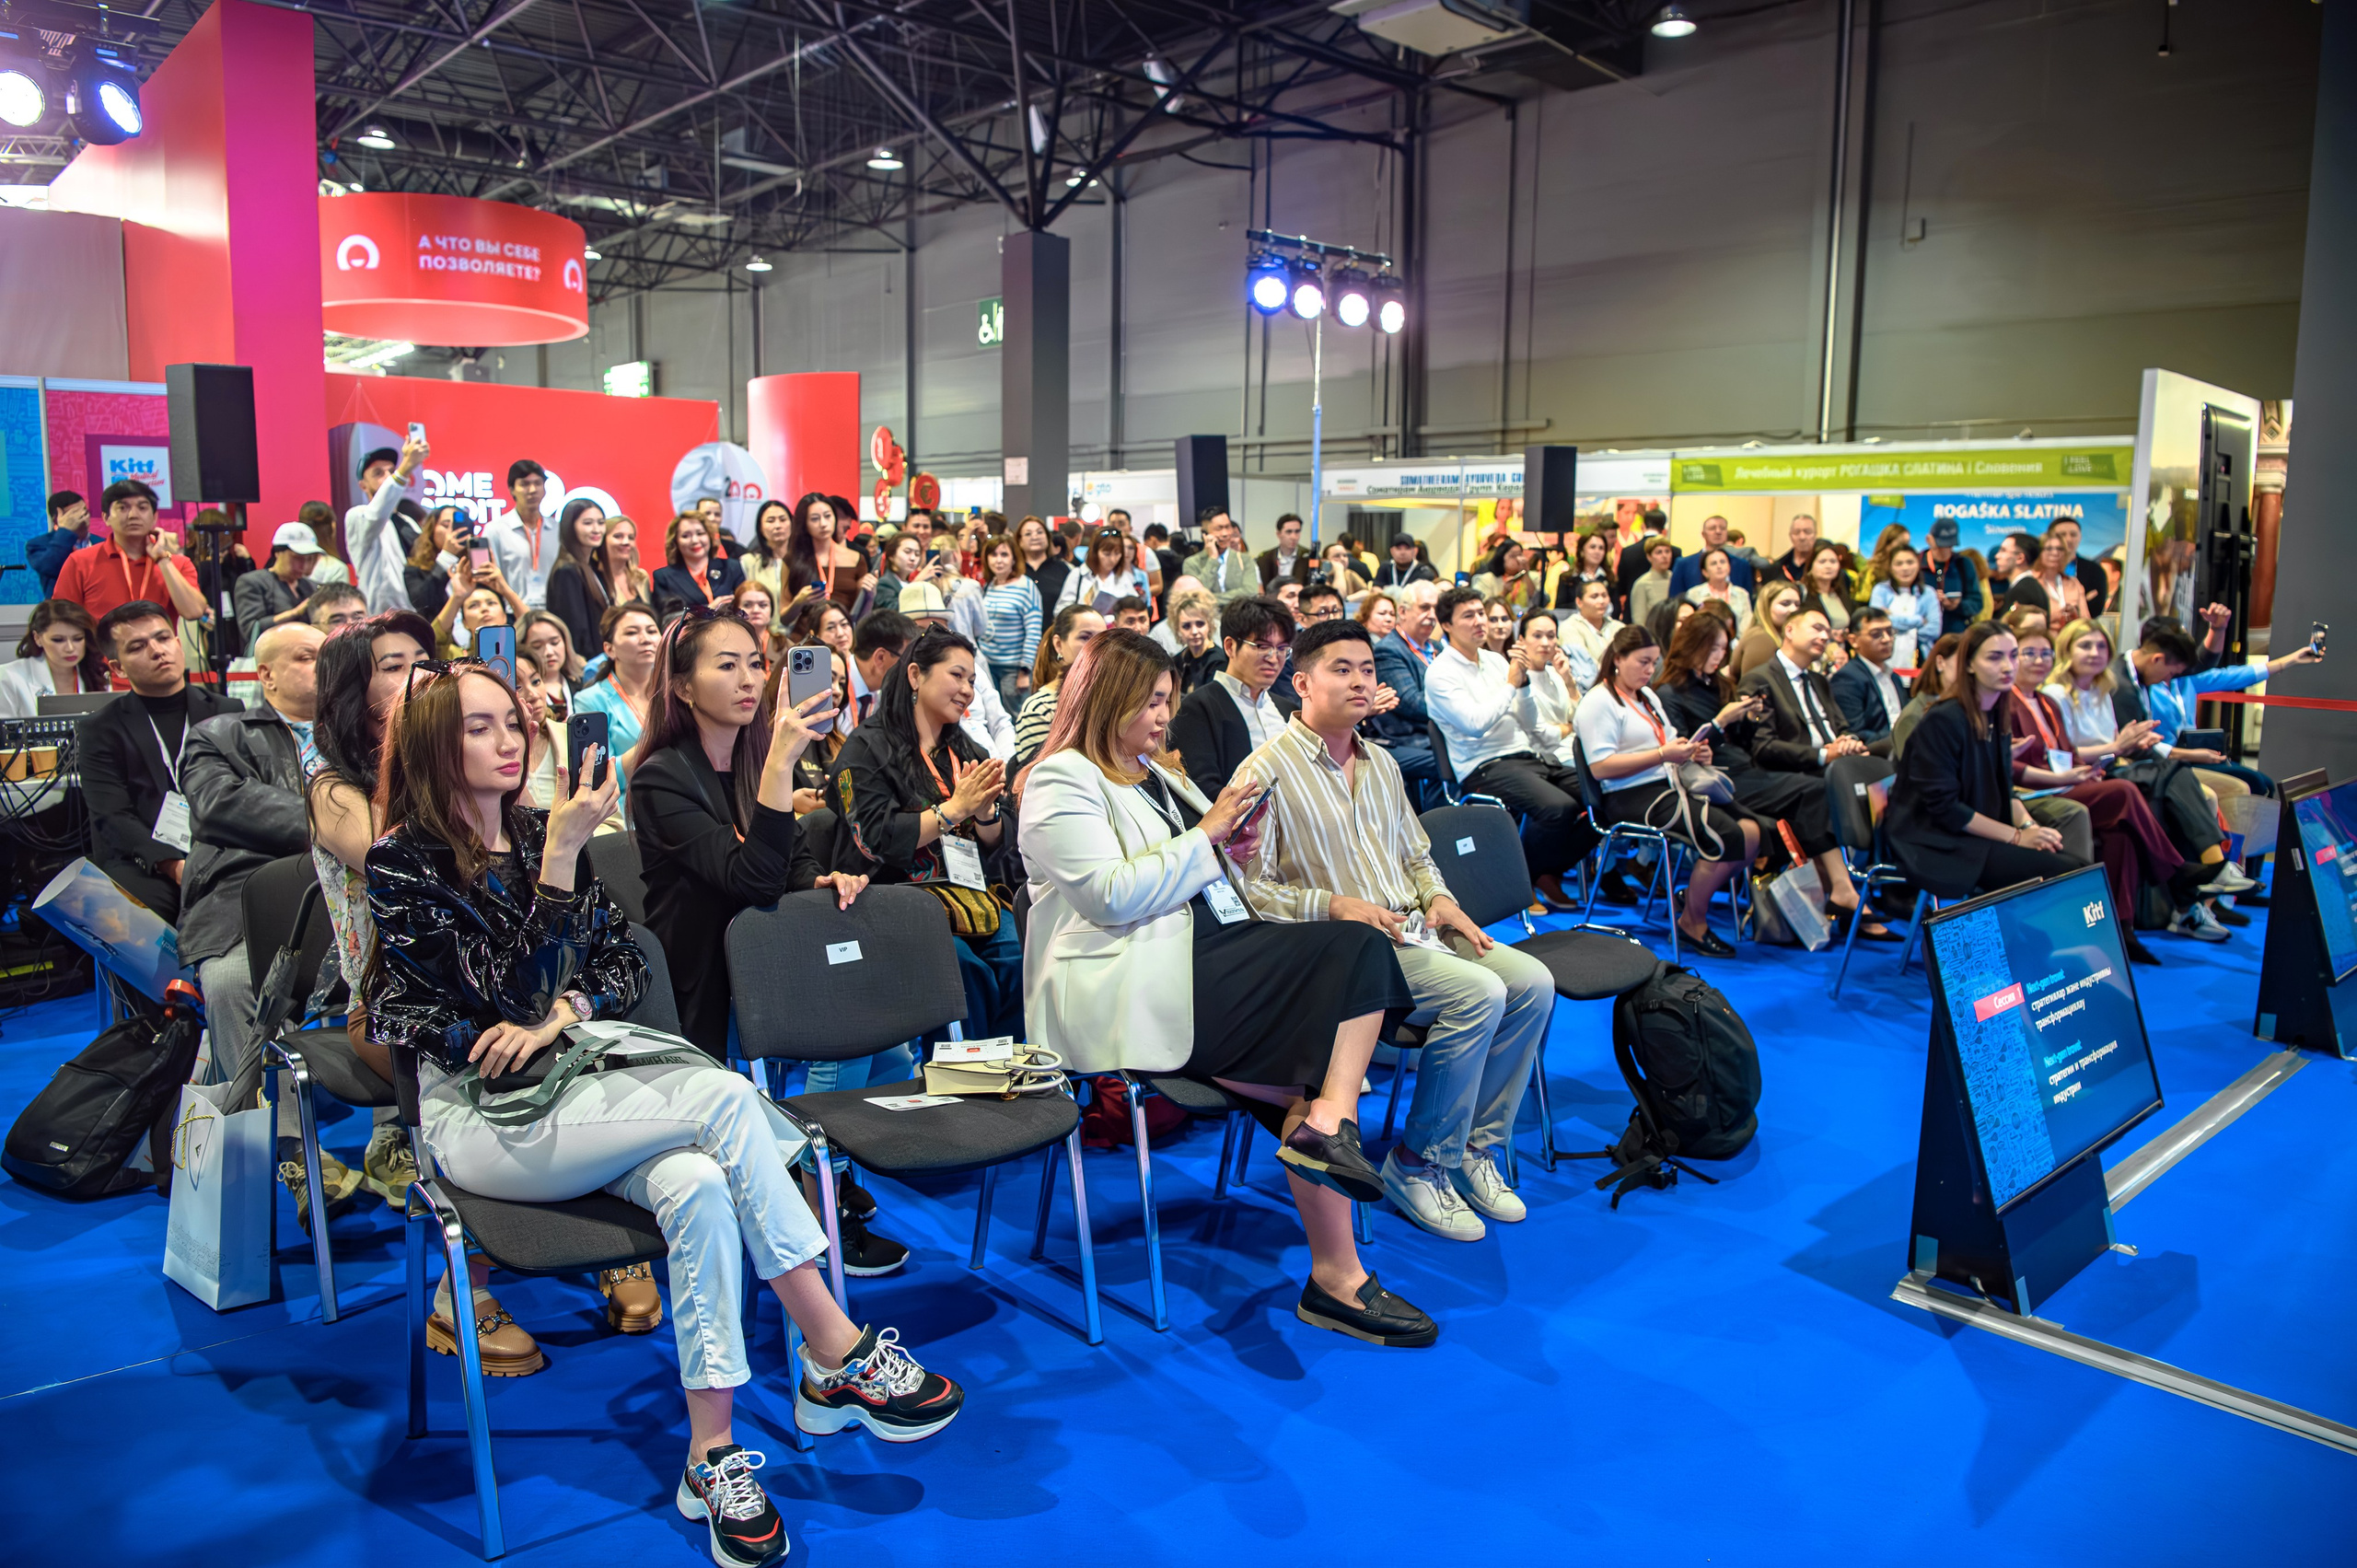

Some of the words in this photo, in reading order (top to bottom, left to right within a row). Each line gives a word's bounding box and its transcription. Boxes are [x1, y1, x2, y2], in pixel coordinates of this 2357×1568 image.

[419, 235, 432, 250] А
[435, 236, 471, 251] ЧТО
[475, 238, 501, 255] ВЫ
[504, 242, 540, 262] СЕБЕ
[419, 255, 541, 282] ПОЗВОЛЯЕТЕ?
[110, 458, 154, 473] Kitf
[1795, 467, 1838, 481] курорт
[1840, 462, 1900, 478] РОГАШКА
[1903, 462, 1964, 476] СЛАТИНА
[1975, 460, 2043, 474] Словения
[423, 469, 493, 498] OME
[1933, 501, 2011, 519] ROGAŠKA
[2014, 504, 2084, 519] SLATINA
[2083, 900, 2105, 924] Kitf
[1993, 992, 2016, 1009] Сессия
[2049, 1064, 2075, 1086] стратегии
[2053, 1081, 2083, 1104] индустрии
